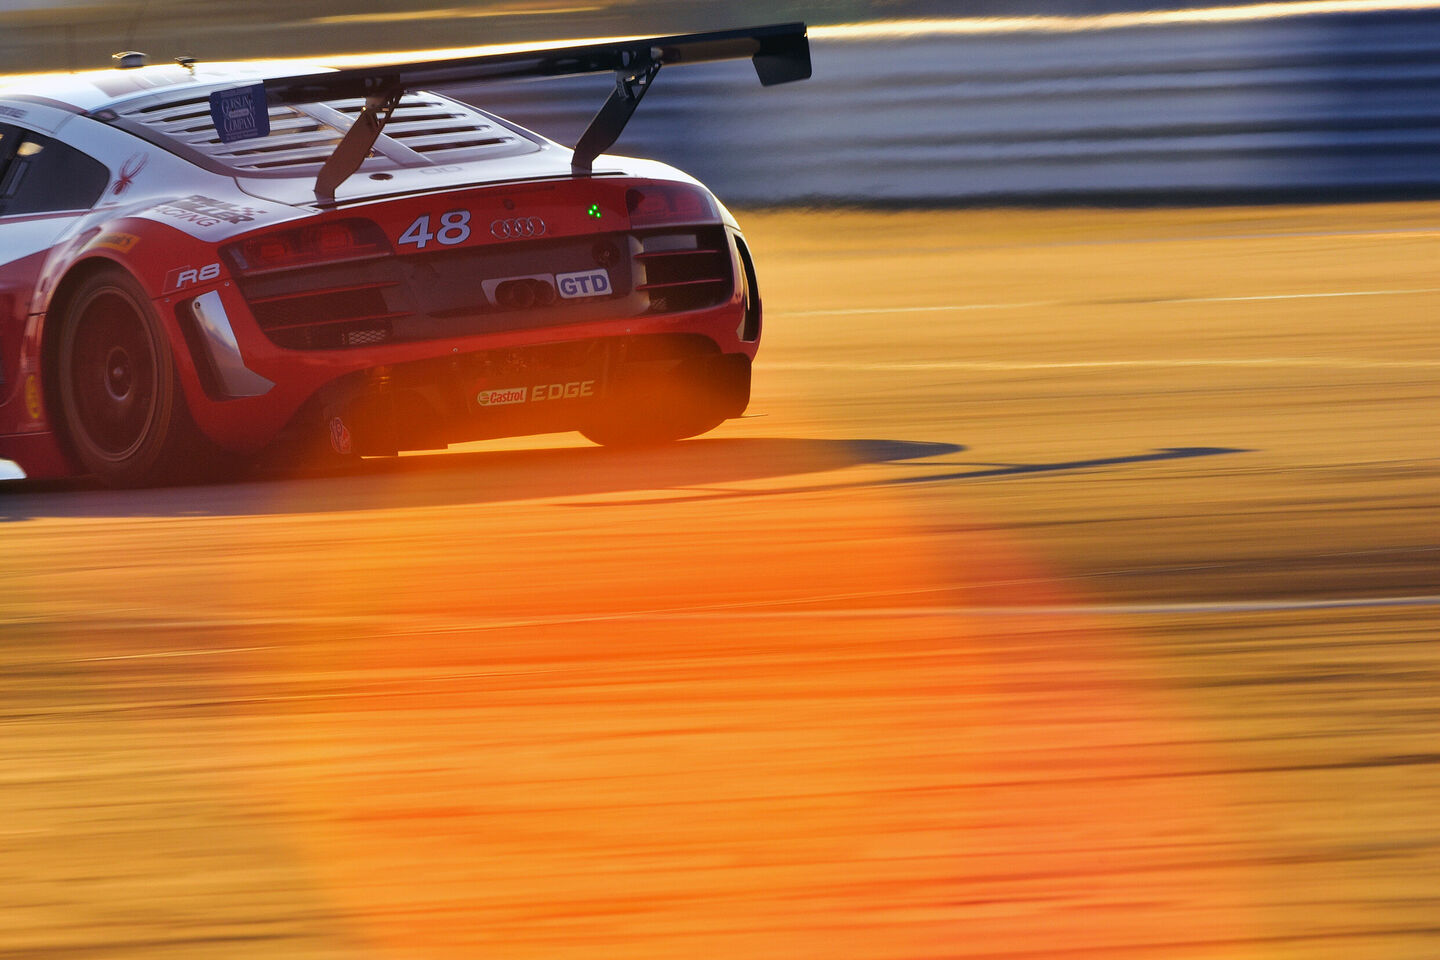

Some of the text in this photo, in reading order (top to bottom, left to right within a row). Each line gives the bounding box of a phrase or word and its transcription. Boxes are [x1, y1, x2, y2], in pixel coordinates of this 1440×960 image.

[398, 209, 472, 249] 48
[176, 263, 220, 288] R8
[560, 274, 608, 296] GTD
[489, 380, 595, 404] Castrol EDGE
